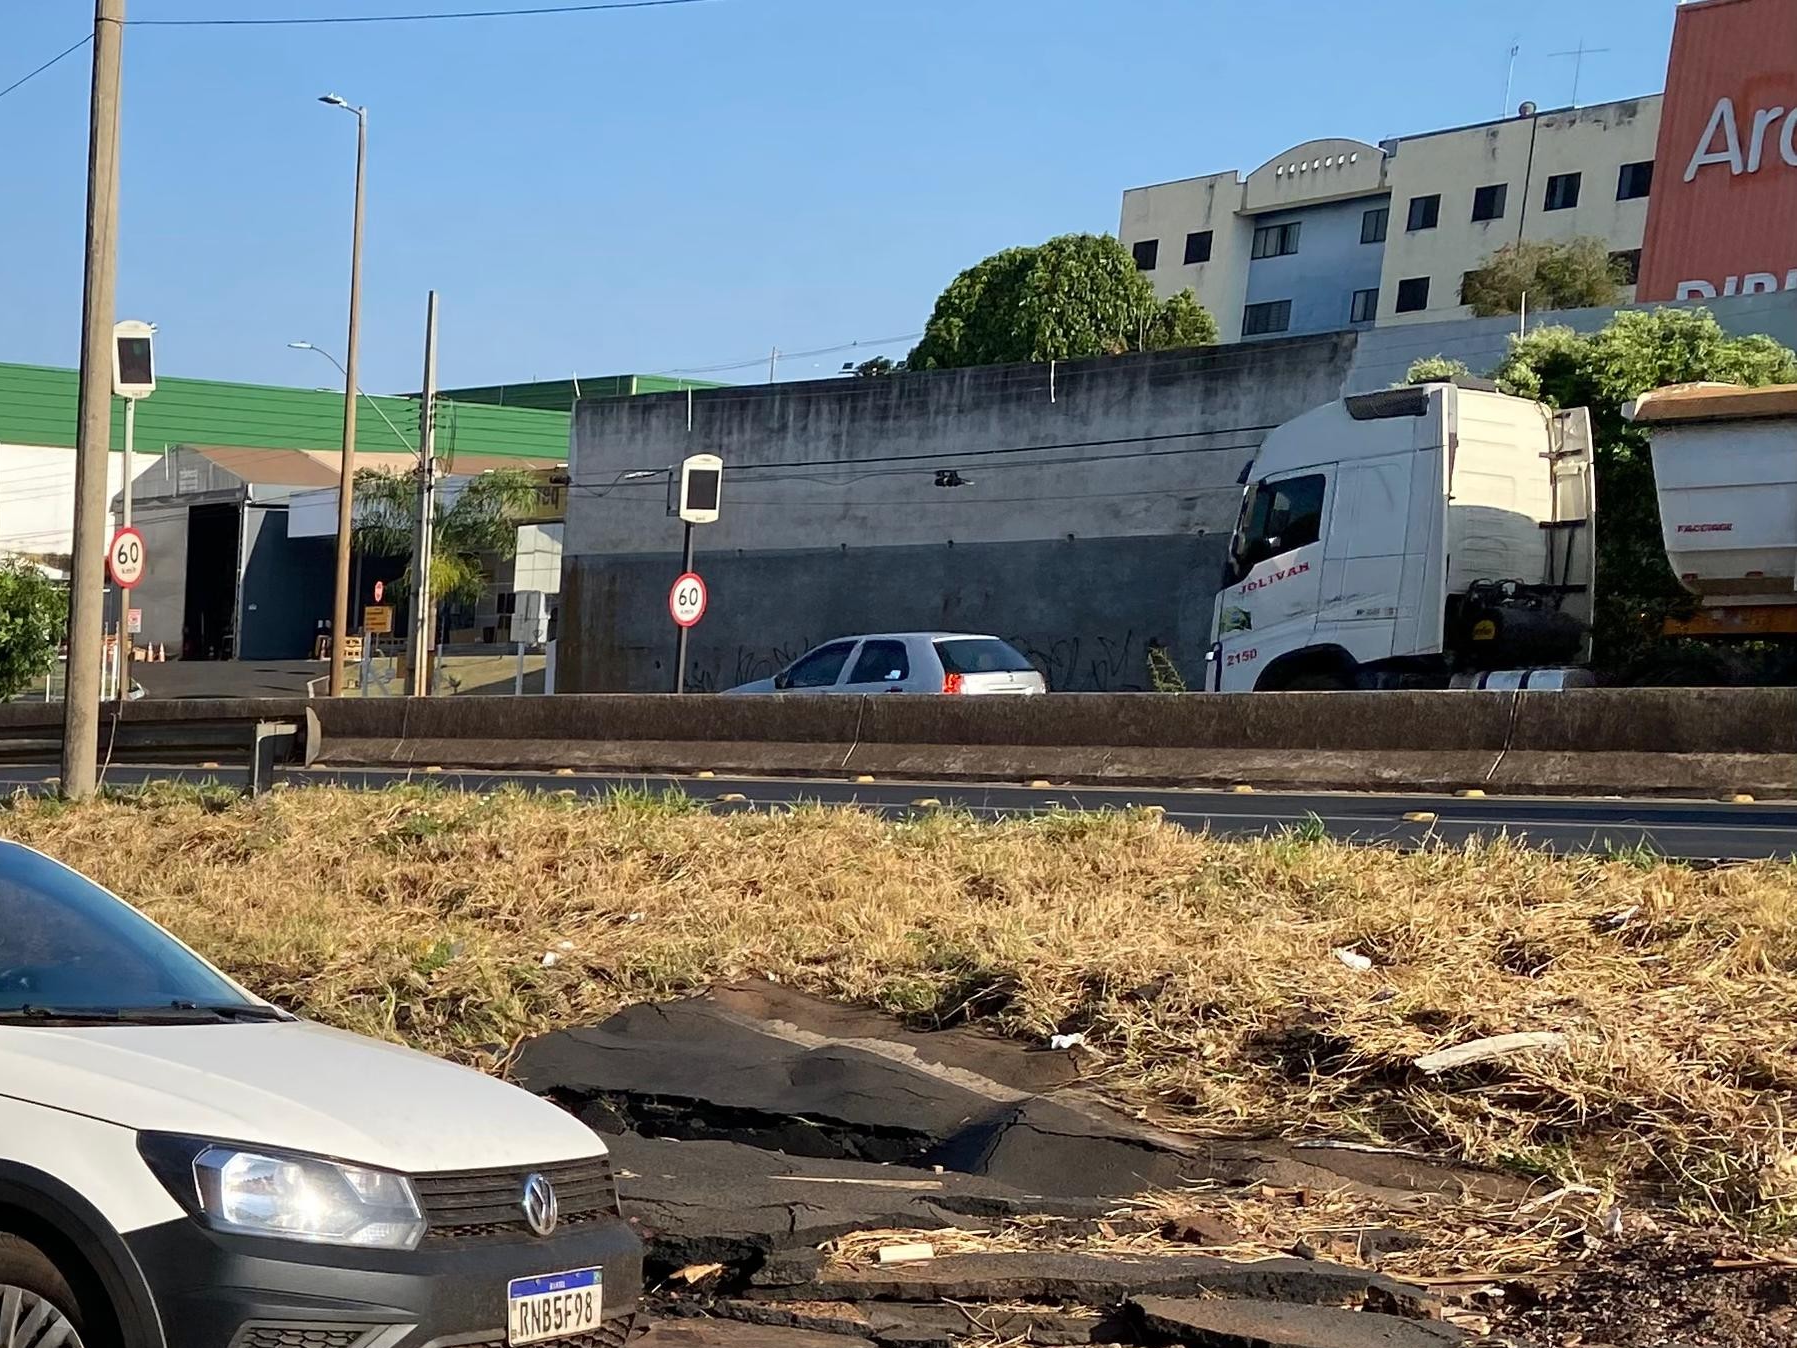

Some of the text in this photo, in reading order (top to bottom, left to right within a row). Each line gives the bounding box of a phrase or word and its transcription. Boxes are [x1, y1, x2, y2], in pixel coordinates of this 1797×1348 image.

[117, 542, 139, 565] 60
[678, 587, 698, 606] 60
[1226, 648, 1258, 667] 2150
[519, 1291, 593, 1338] RNB5F98
